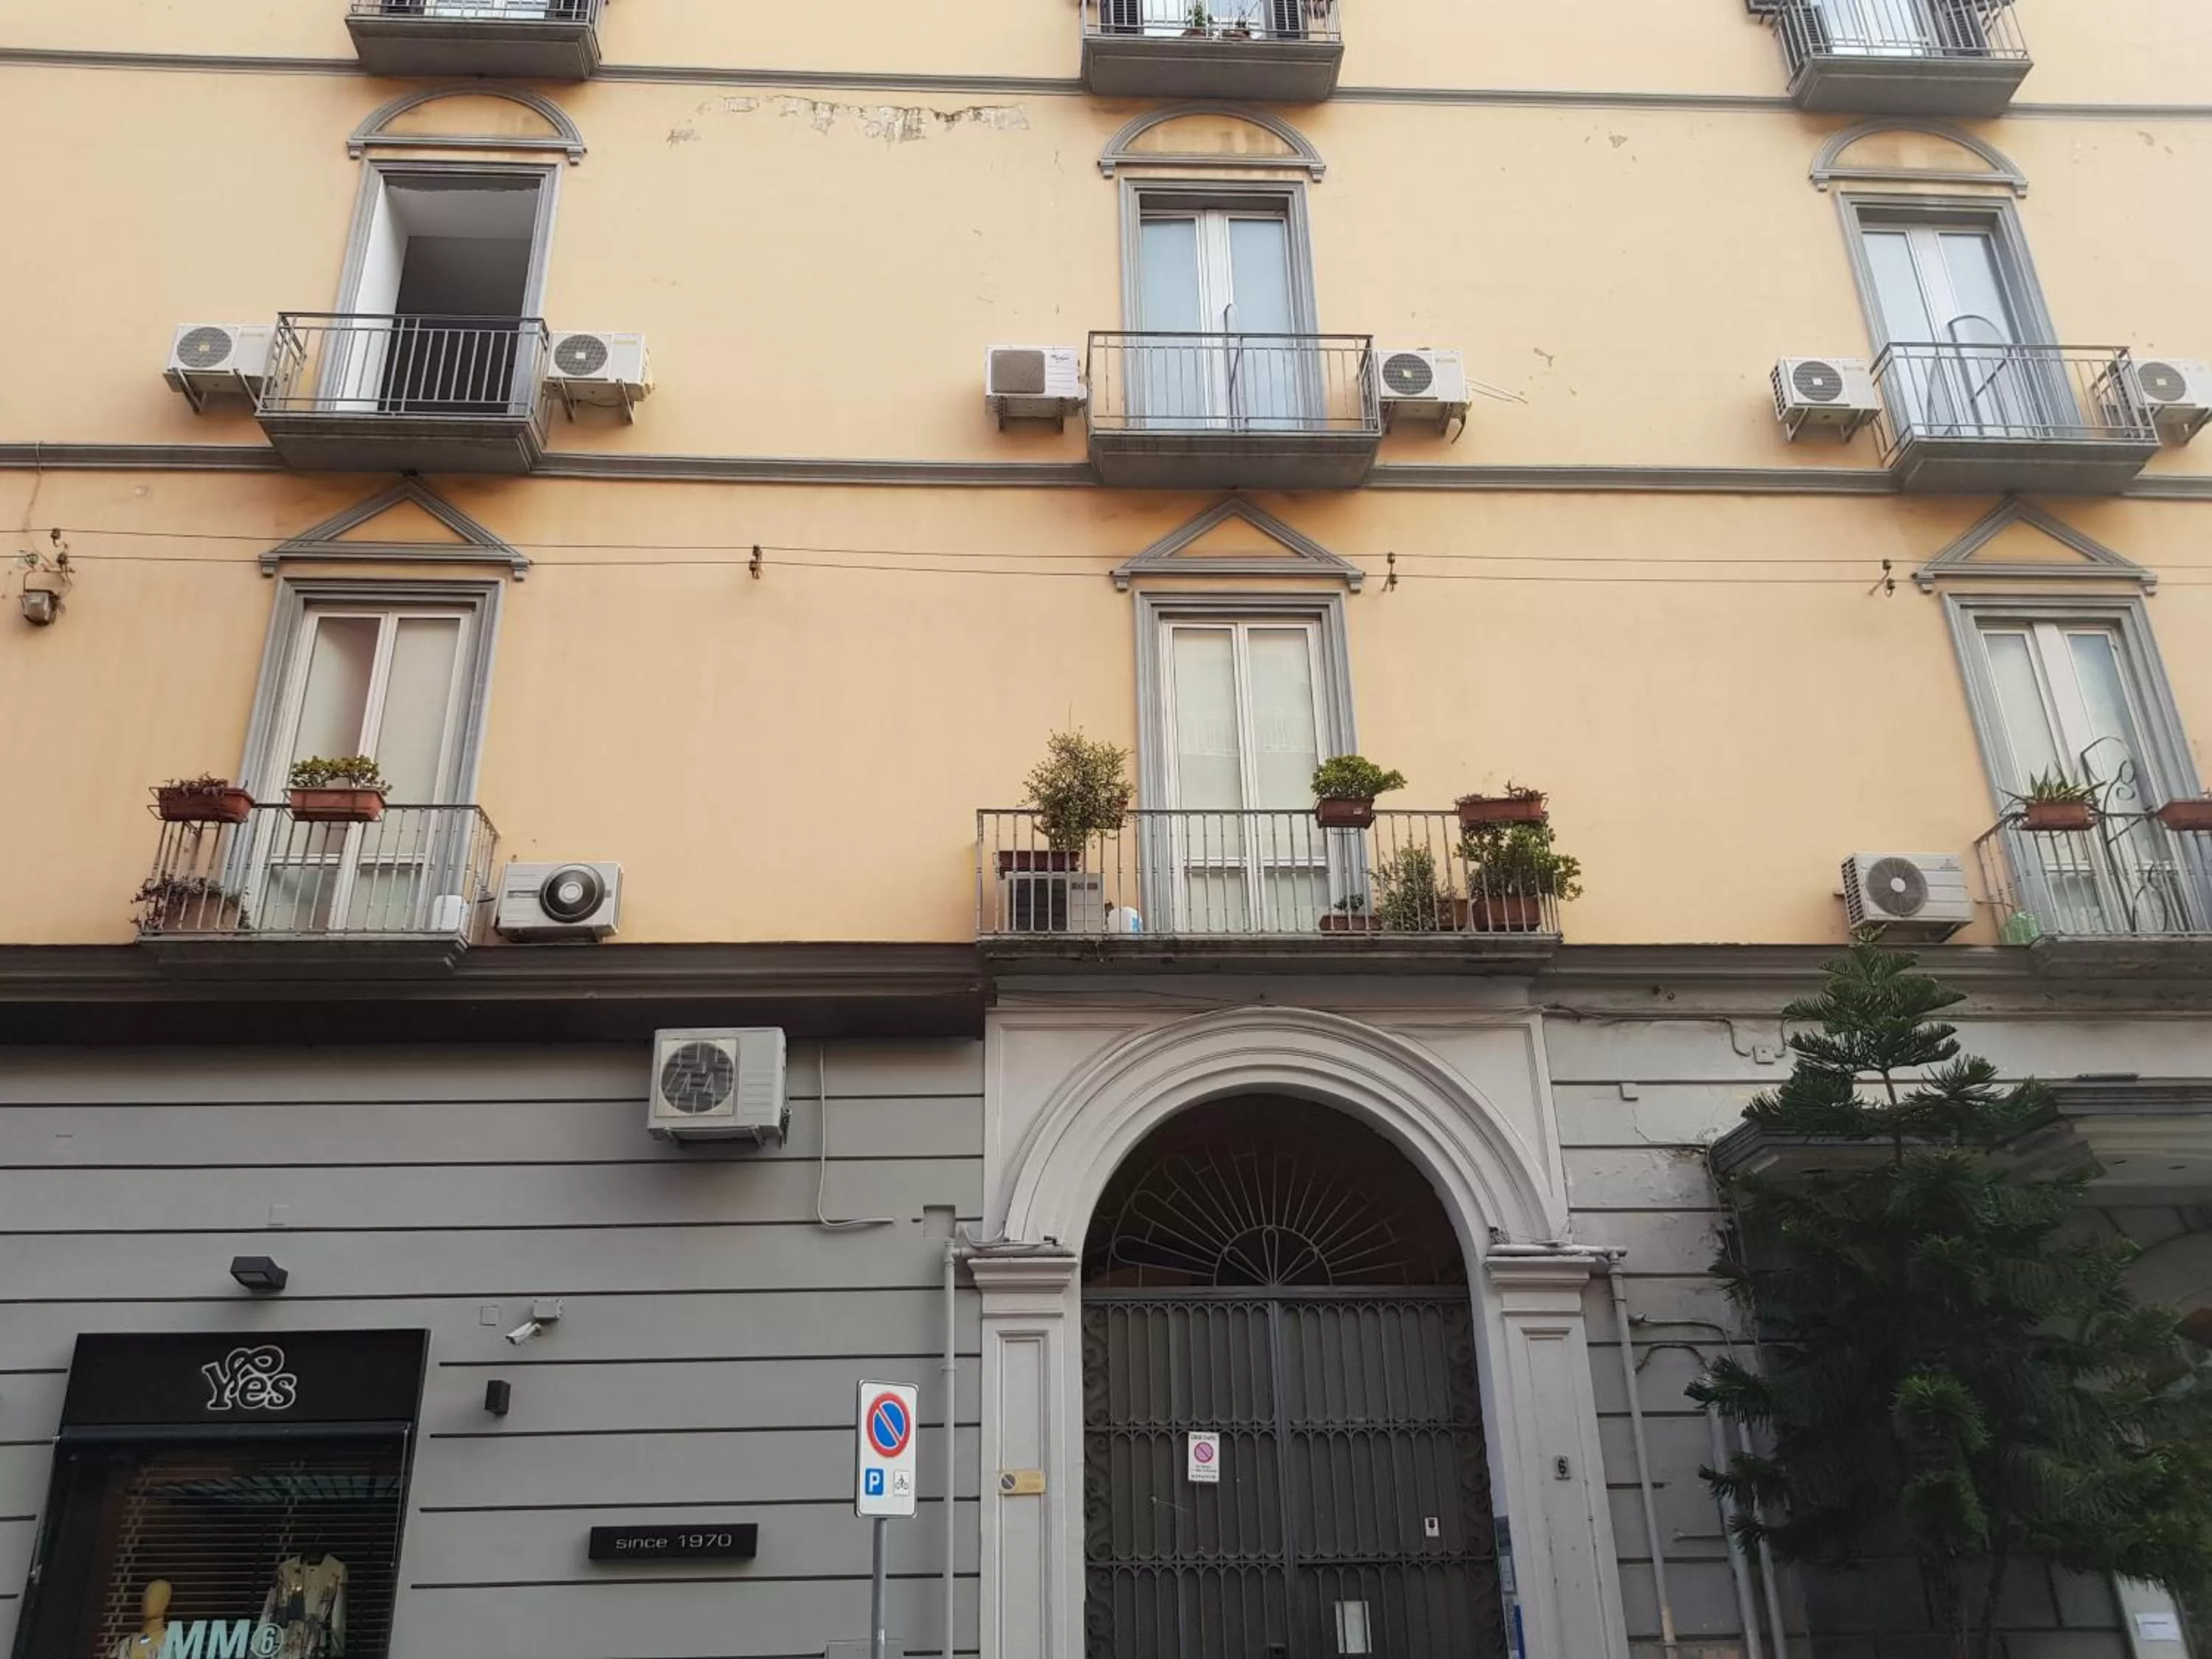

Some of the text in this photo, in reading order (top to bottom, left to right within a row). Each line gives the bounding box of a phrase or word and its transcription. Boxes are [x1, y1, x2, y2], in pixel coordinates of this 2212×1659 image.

[869, 1472, 880, 1492] P
[616, 1533, 732, 1549] since 1970
